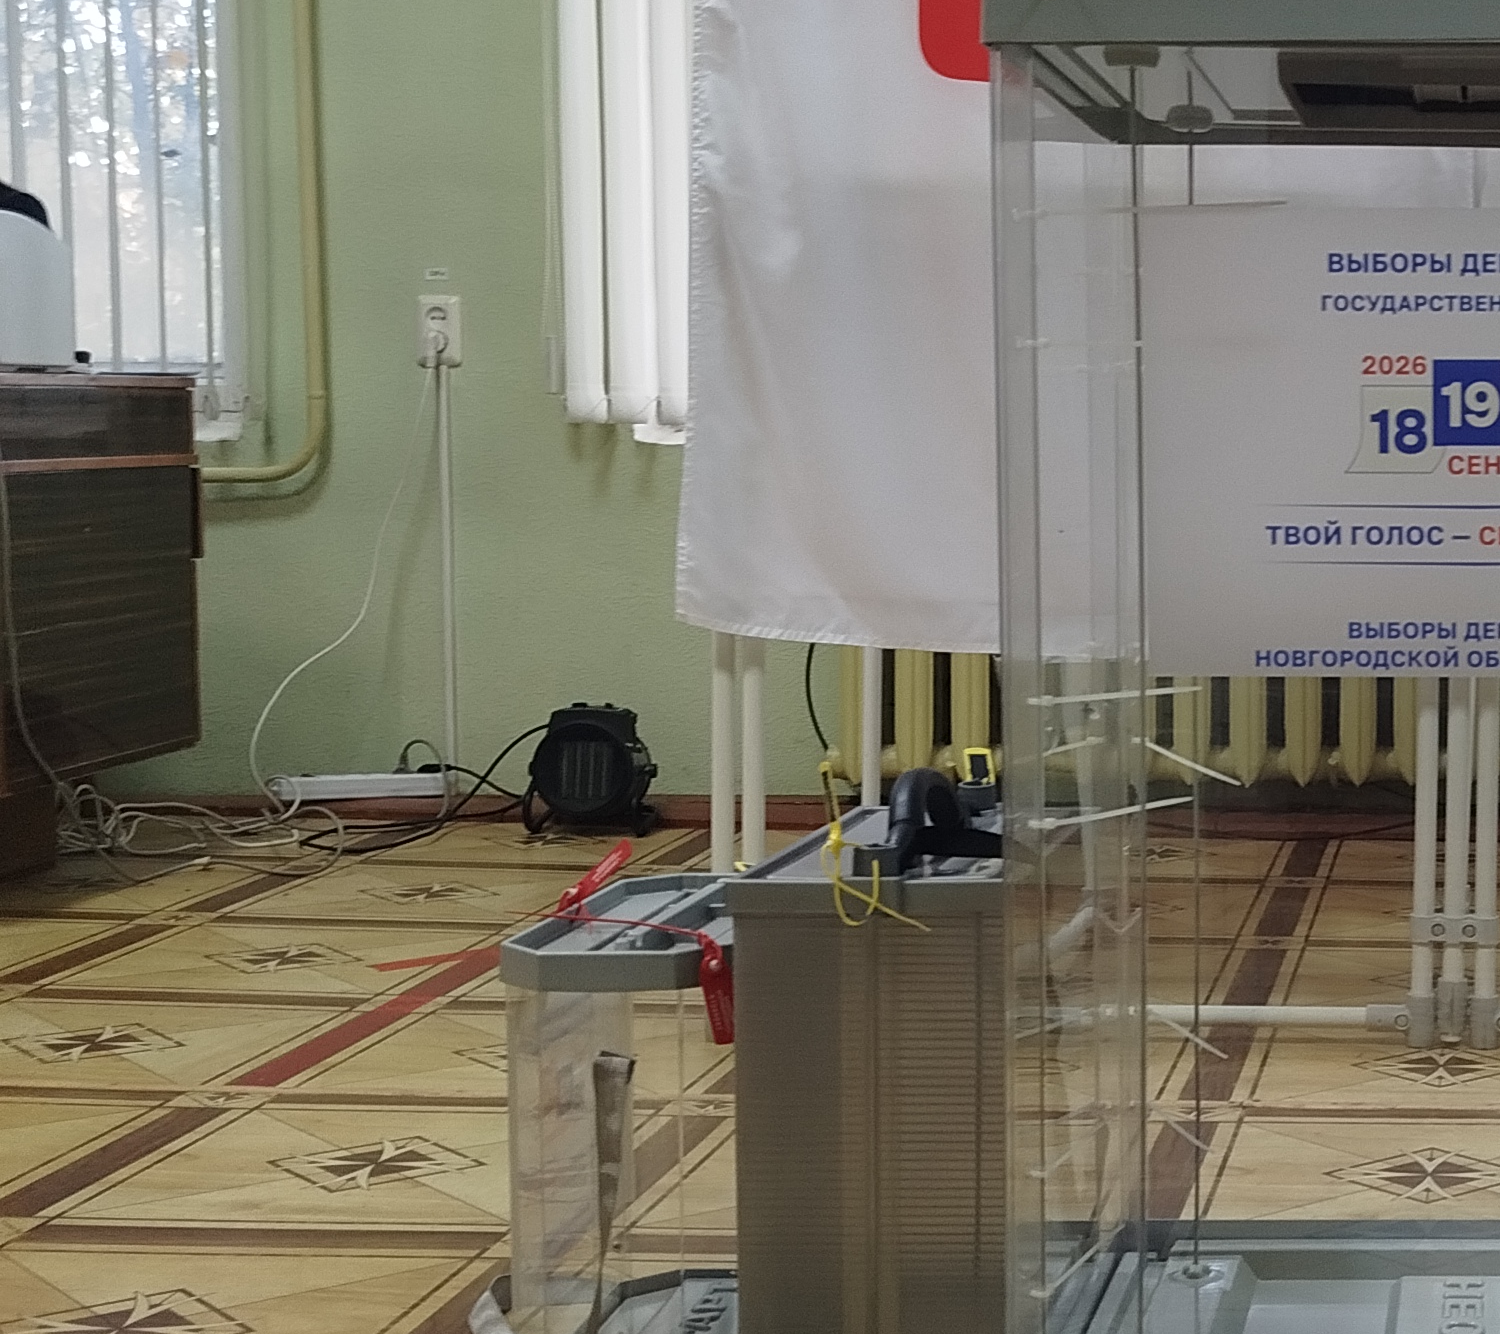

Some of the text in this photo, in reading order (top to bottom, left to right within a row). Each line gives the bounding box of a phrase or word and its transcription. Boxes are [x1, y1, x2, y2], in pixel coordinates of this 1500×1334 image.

[1327, 252, 1452, 274] ВЫБОРЫ
[1361, 355, 1427, 376] 2026
[1370, 407, 1428, 455] 18
[1440, 380, 1500, 429] 19
[1265, 520, 1342, 546] ТВОЙ
[1351, 525, 1444, 546] ГОЛОС
[1348, 621, 1457, 641] ВЫБОРЫ
[1254, 645, 1460, 671] НОВГОРОДСКОЙ
